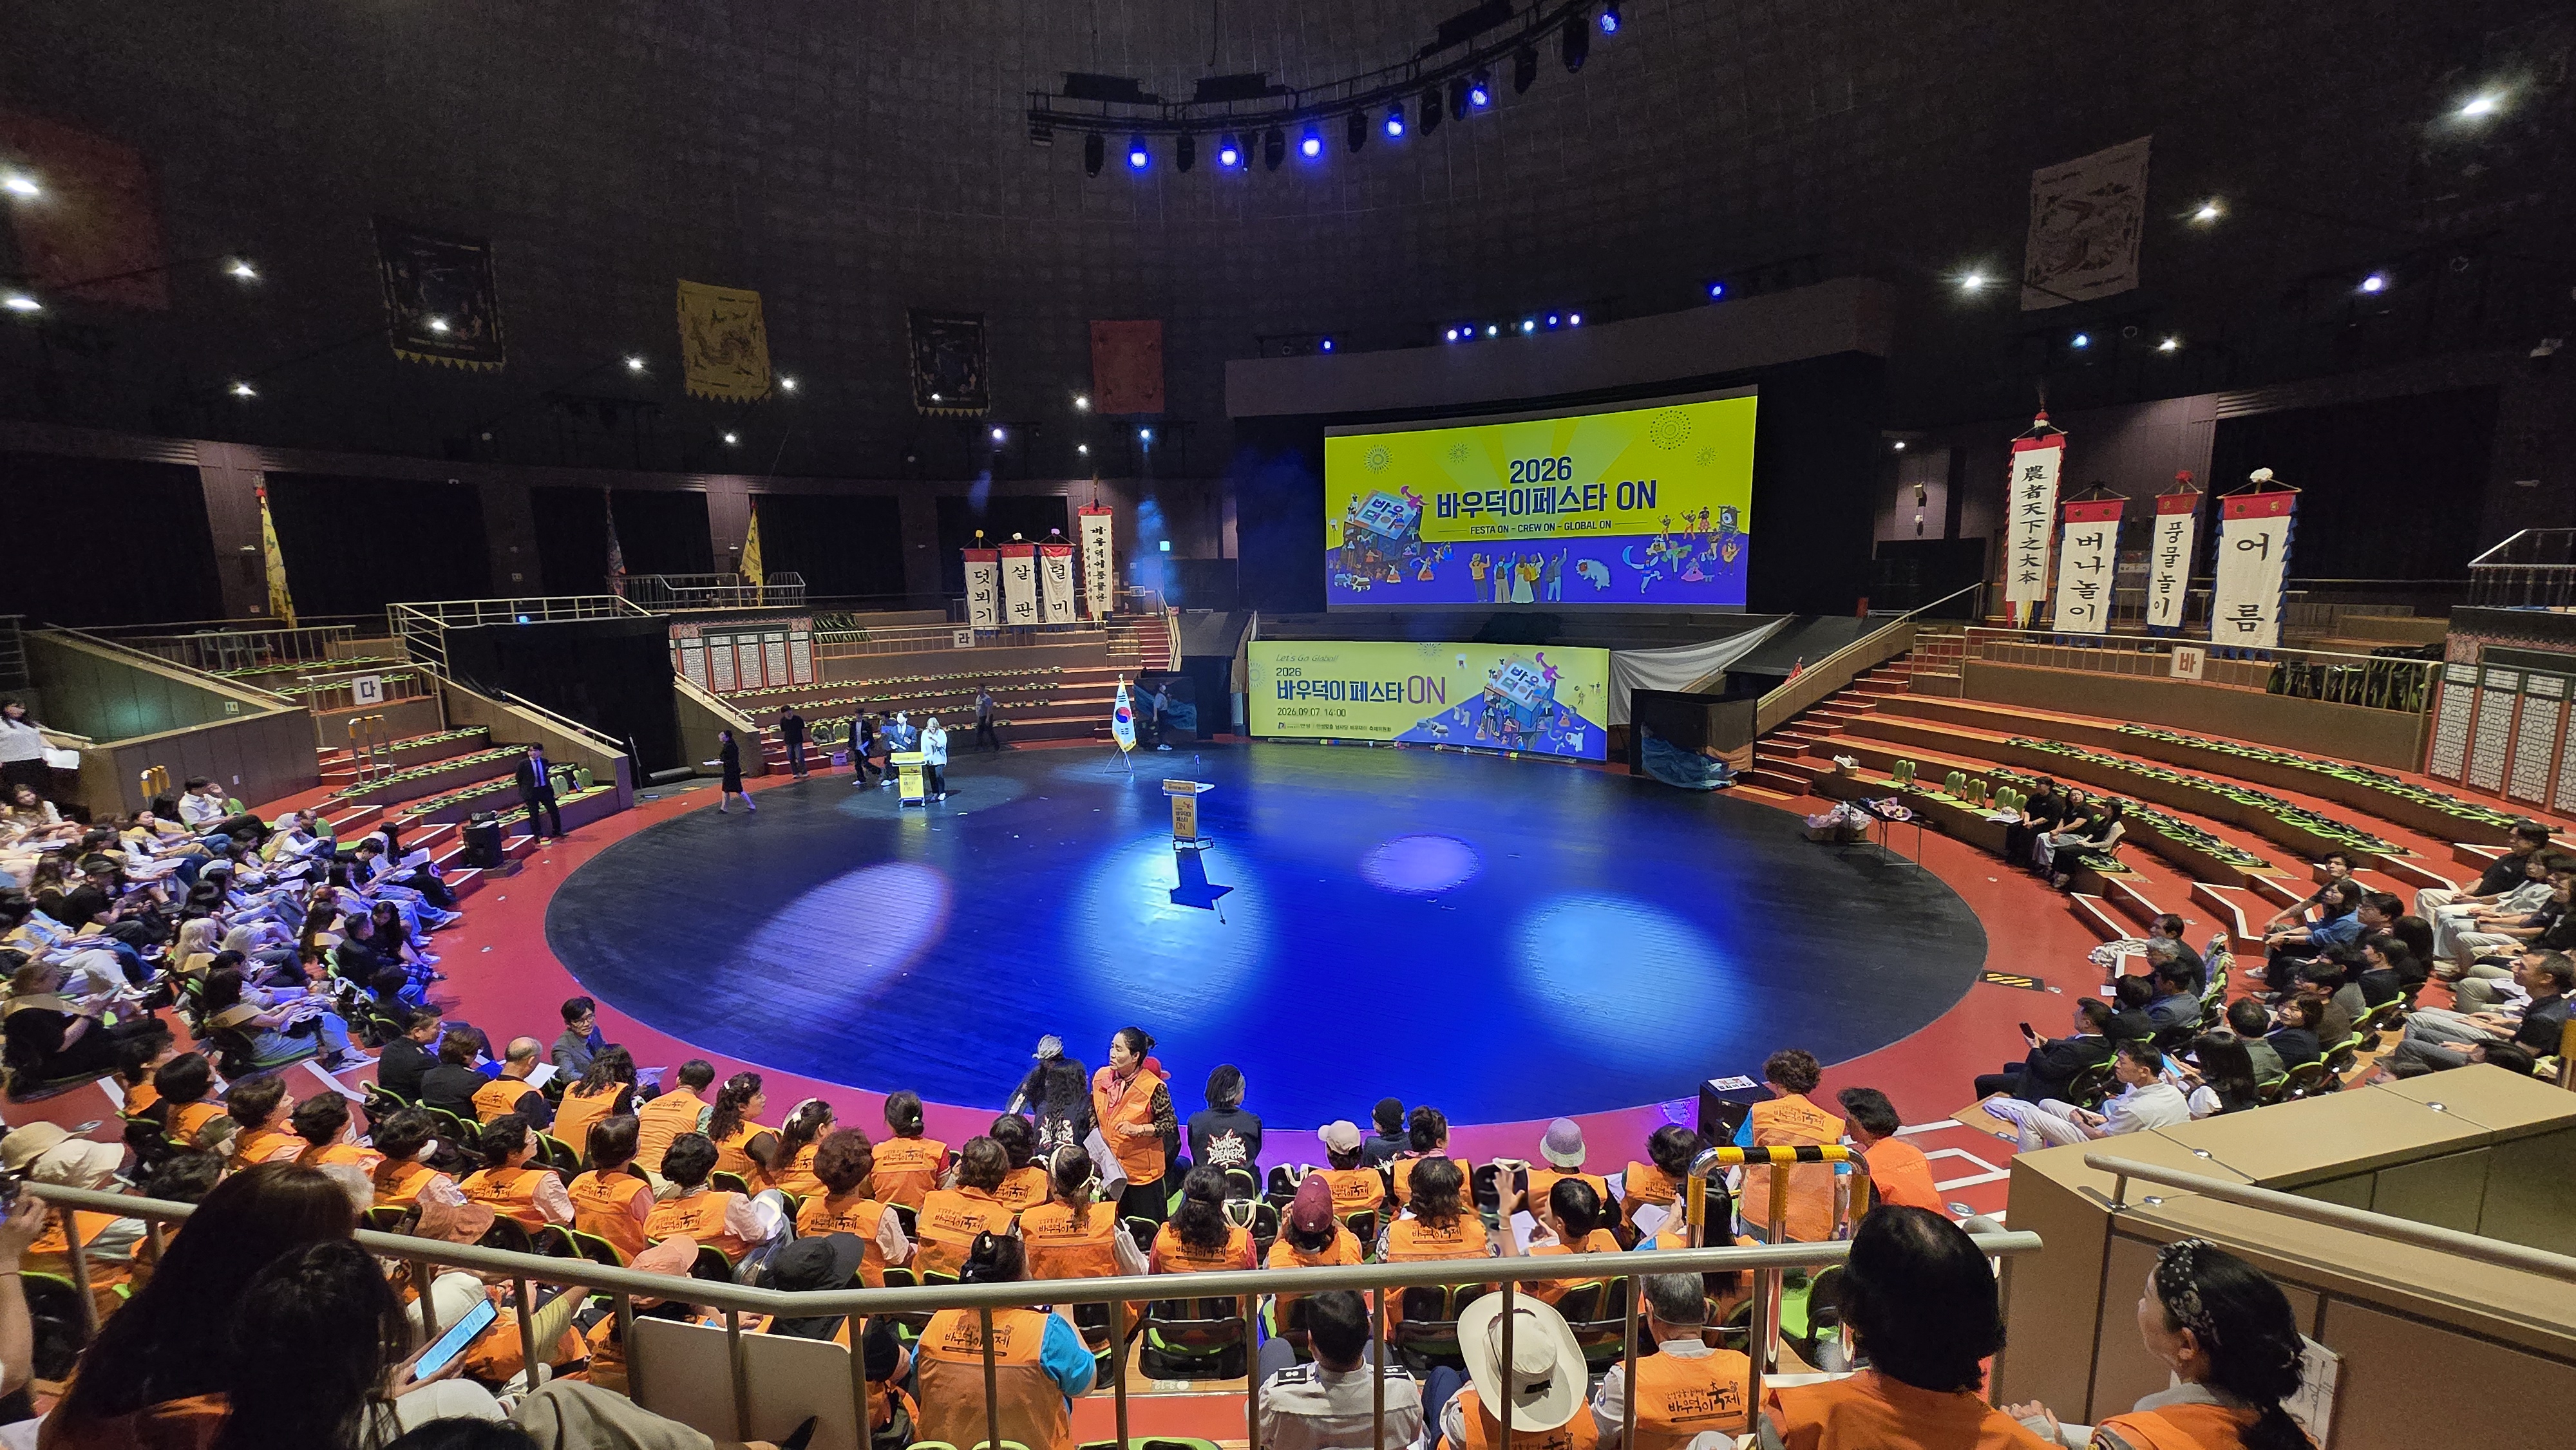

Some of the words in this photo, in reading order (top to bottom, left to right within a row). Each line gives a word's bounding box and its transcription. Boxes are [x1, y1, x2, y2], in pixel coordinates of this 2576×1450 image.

[1510, 457, 1572, 484] 2026
[1437, 484, 1608, 519] 바우덕이페스타
[1616, 480, 1657, 511] ON
[1470, 526, 1495, 534] FESTA
[1497, 525, 1509, 534] ON
[1517, 523, 1542, 533] CREW
[1544, 523, 1555, 532] ON
[1564, 522, 1597, 532] GLOBAL
[1599, 520, 1612, 529] ON
[2016, 465, 2047, 585] 農者天下之大本
[2069, 532, 2106, 623] 버나놀이
[2154, 521, 2184, 619] 풍물놀이
[2226, 532, 2269, 632] 어름
[973, 569, 992, 623] 덧뵈기
[1012, 565, 1034, 618] 살판
[1050, 565, 1068, 616] 덜미
[958, 632, 970, 644] 라
[1276, 654, 1296, 662] Let's
[1276, 667, 1302, 676] 2026
[2179, 652, 2197, 673] 바
[360, 681, 375, 698] 다
[1276, 680, 1345, 700] 바우덕이
[1349, 681, 1405, 703] 페스타
[1408, 675, 1446, 704] ON
[1325, 708, 1346, 717] 14:00
[945, 1330, 1010, 1348] 바우덕이제
